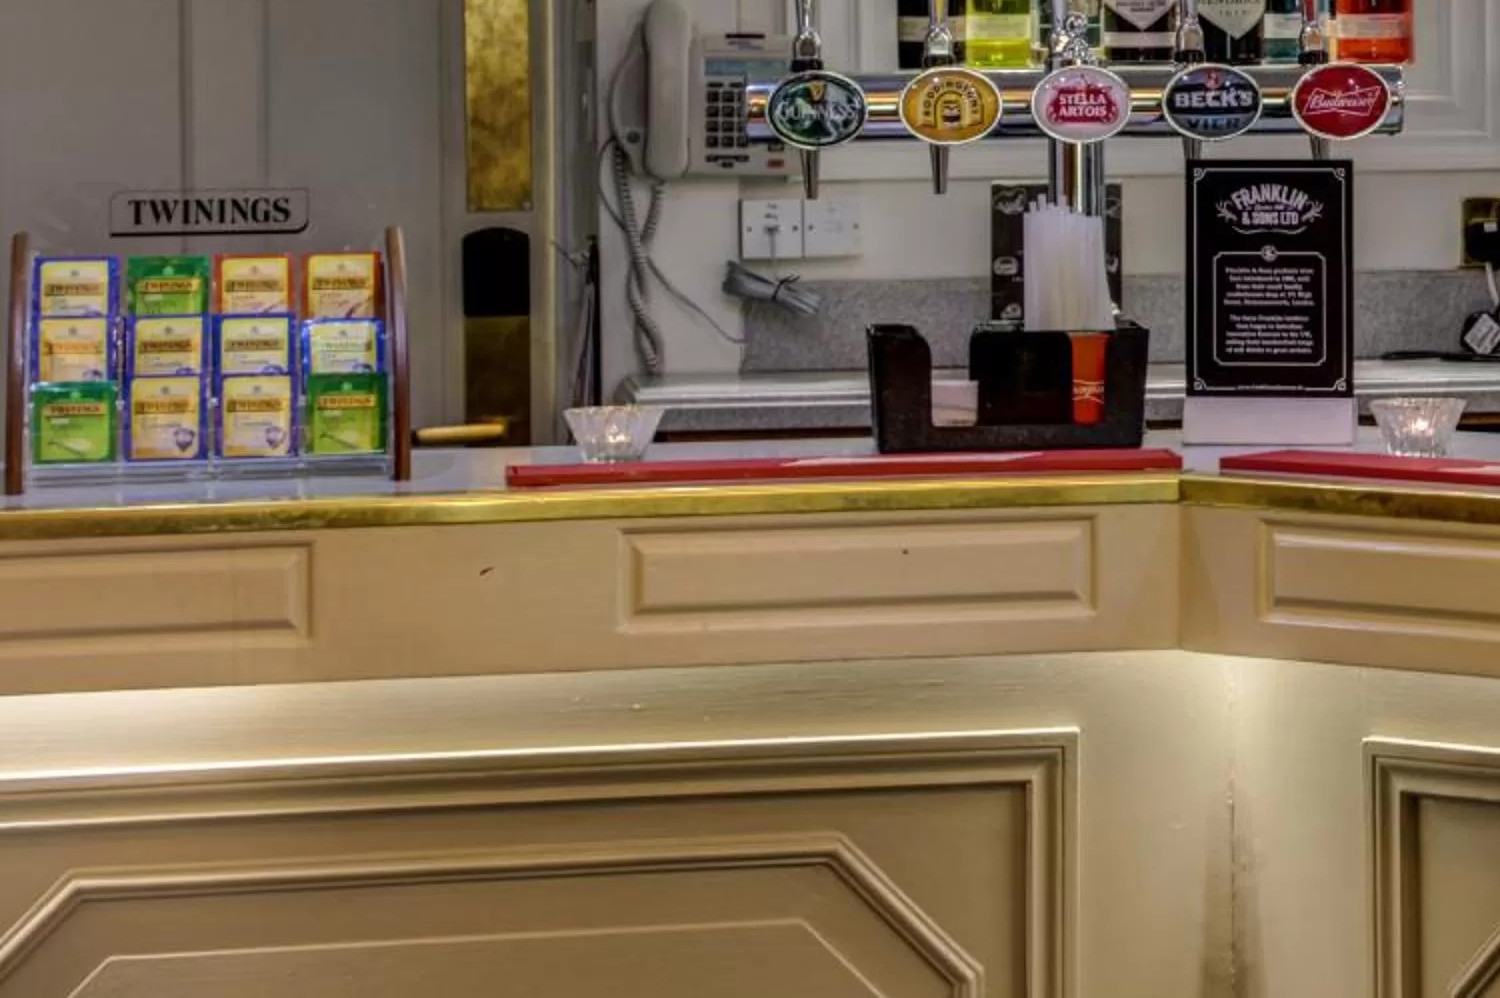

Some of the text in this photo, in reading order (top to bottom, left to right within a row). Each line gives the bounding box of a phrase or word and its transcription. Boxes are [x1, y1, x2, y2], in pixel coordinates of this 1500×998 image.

[1059, 92, 1107, 105] STELLA
[1175, 88, 1253, 108] BECK'S
[1059, 105, 1107, 118] ARTOIS
[1231, 183, 1310, 211] FRANKLIN
[127, 196, 291, 226] TWININGS
[1241, 211, 1299, 226] & SONS LTD
